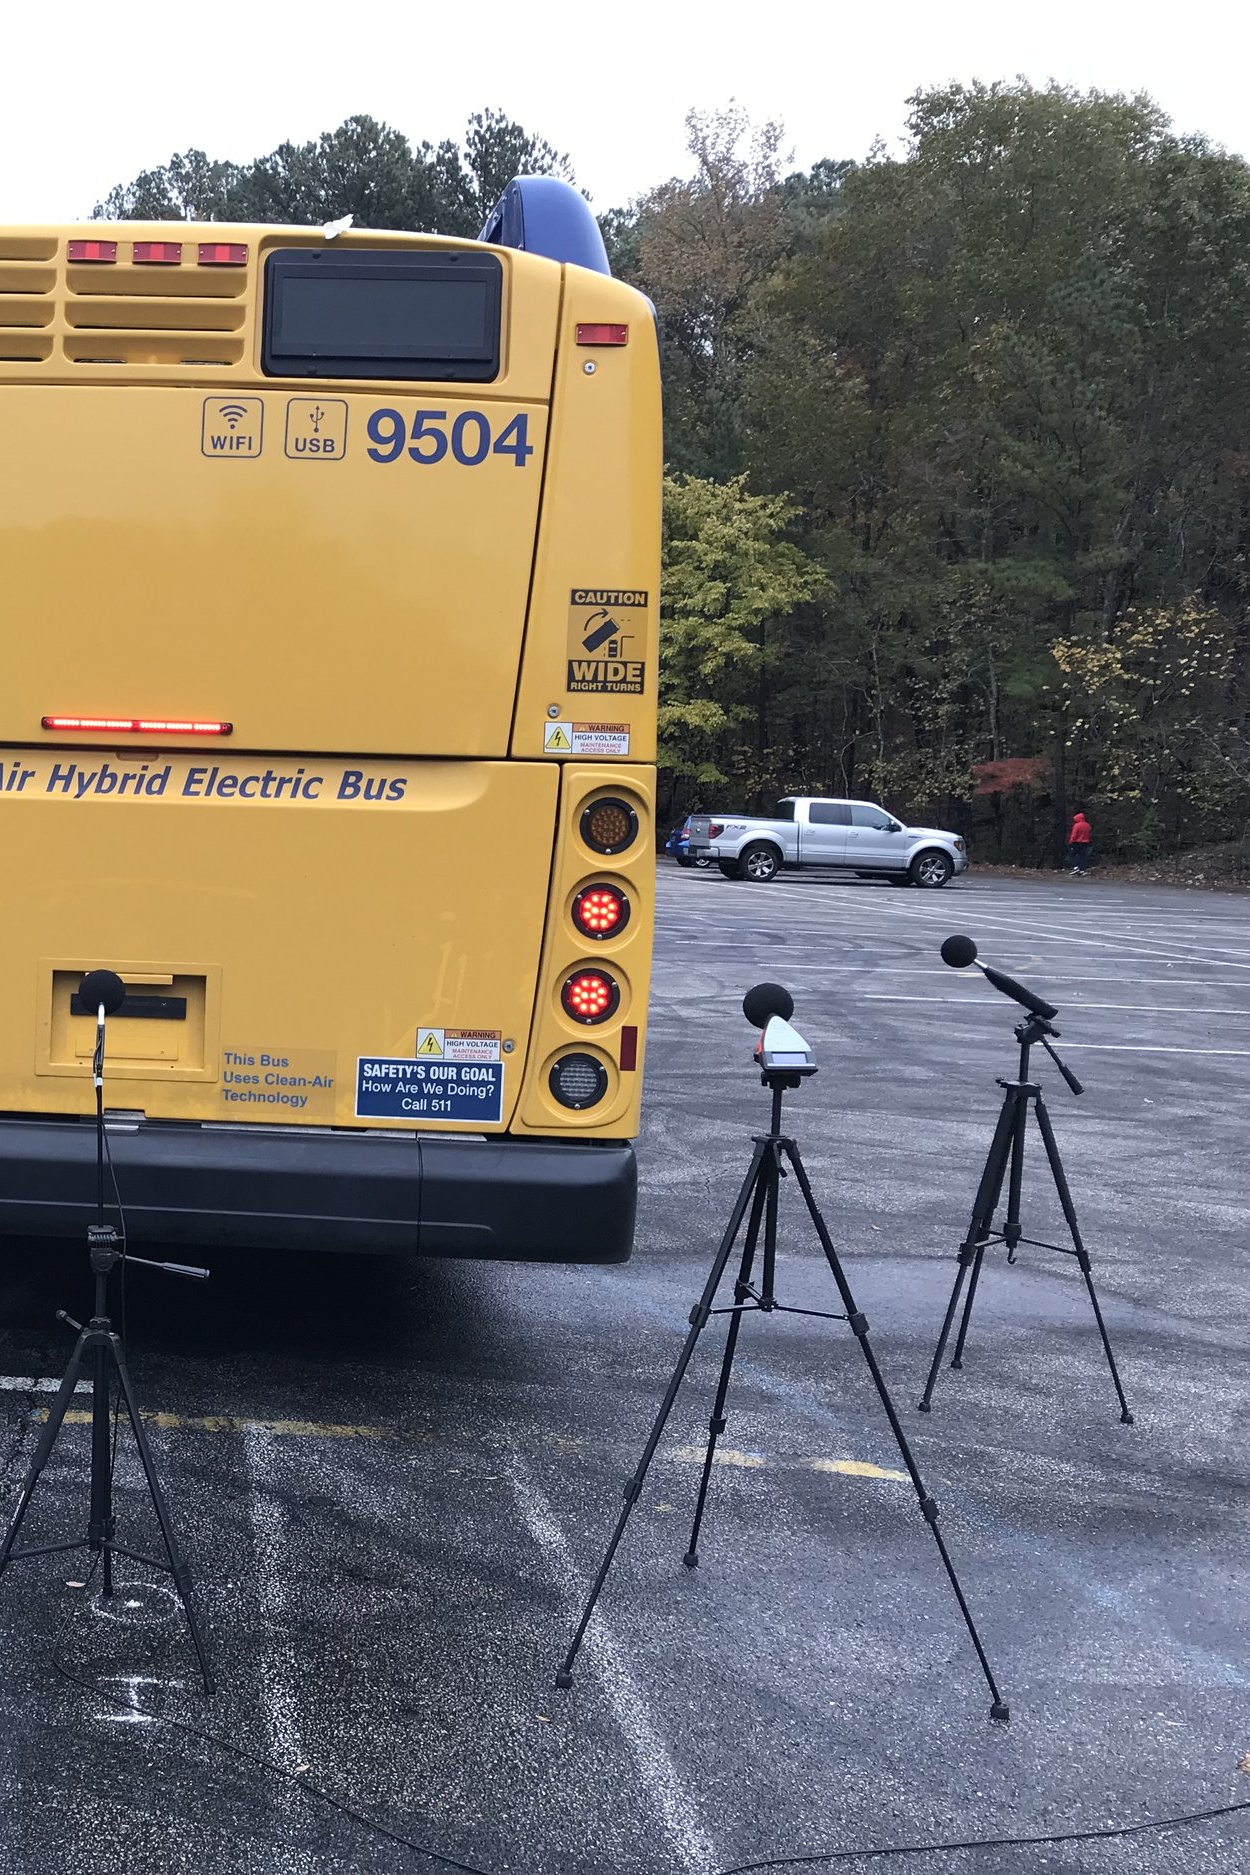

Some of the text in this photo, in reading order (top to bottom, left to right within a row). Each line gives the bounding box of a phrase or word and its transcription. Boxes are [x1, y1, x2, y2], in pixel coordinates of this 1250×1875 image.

[210, 435, 253, 450] WIFI
[294, 437, 336, 453] USB
[366, 407, 534, 468] 9504
[574, 591, 646, 605] CAUTION
[572, 661, 642, 682] WIDE
[570, 682, 641, 692] RIGHT TURNS
[588, 724, 625, 732] WARNING
[594, 734, 627, 742] VOLTAGE
[46, 763, 172, 799] Hybrid
[182, 767, 324, 799] Electric
[337, 771, 407, 801] Bus
[460, 1031, 496, 1039] WARNING
[223, 1052, 289, 1068] This Bus
[223, 1071, 334, 1088] Uses Clean-Air
[363, 1063, 496, 1082] SAFETY'S OUR GOAL
[362, 1080, 494, 1098] How Are We Doing?
[223, 1088, 308, 1108] Technology
[401, 1097, 451, 1112] Call 511
